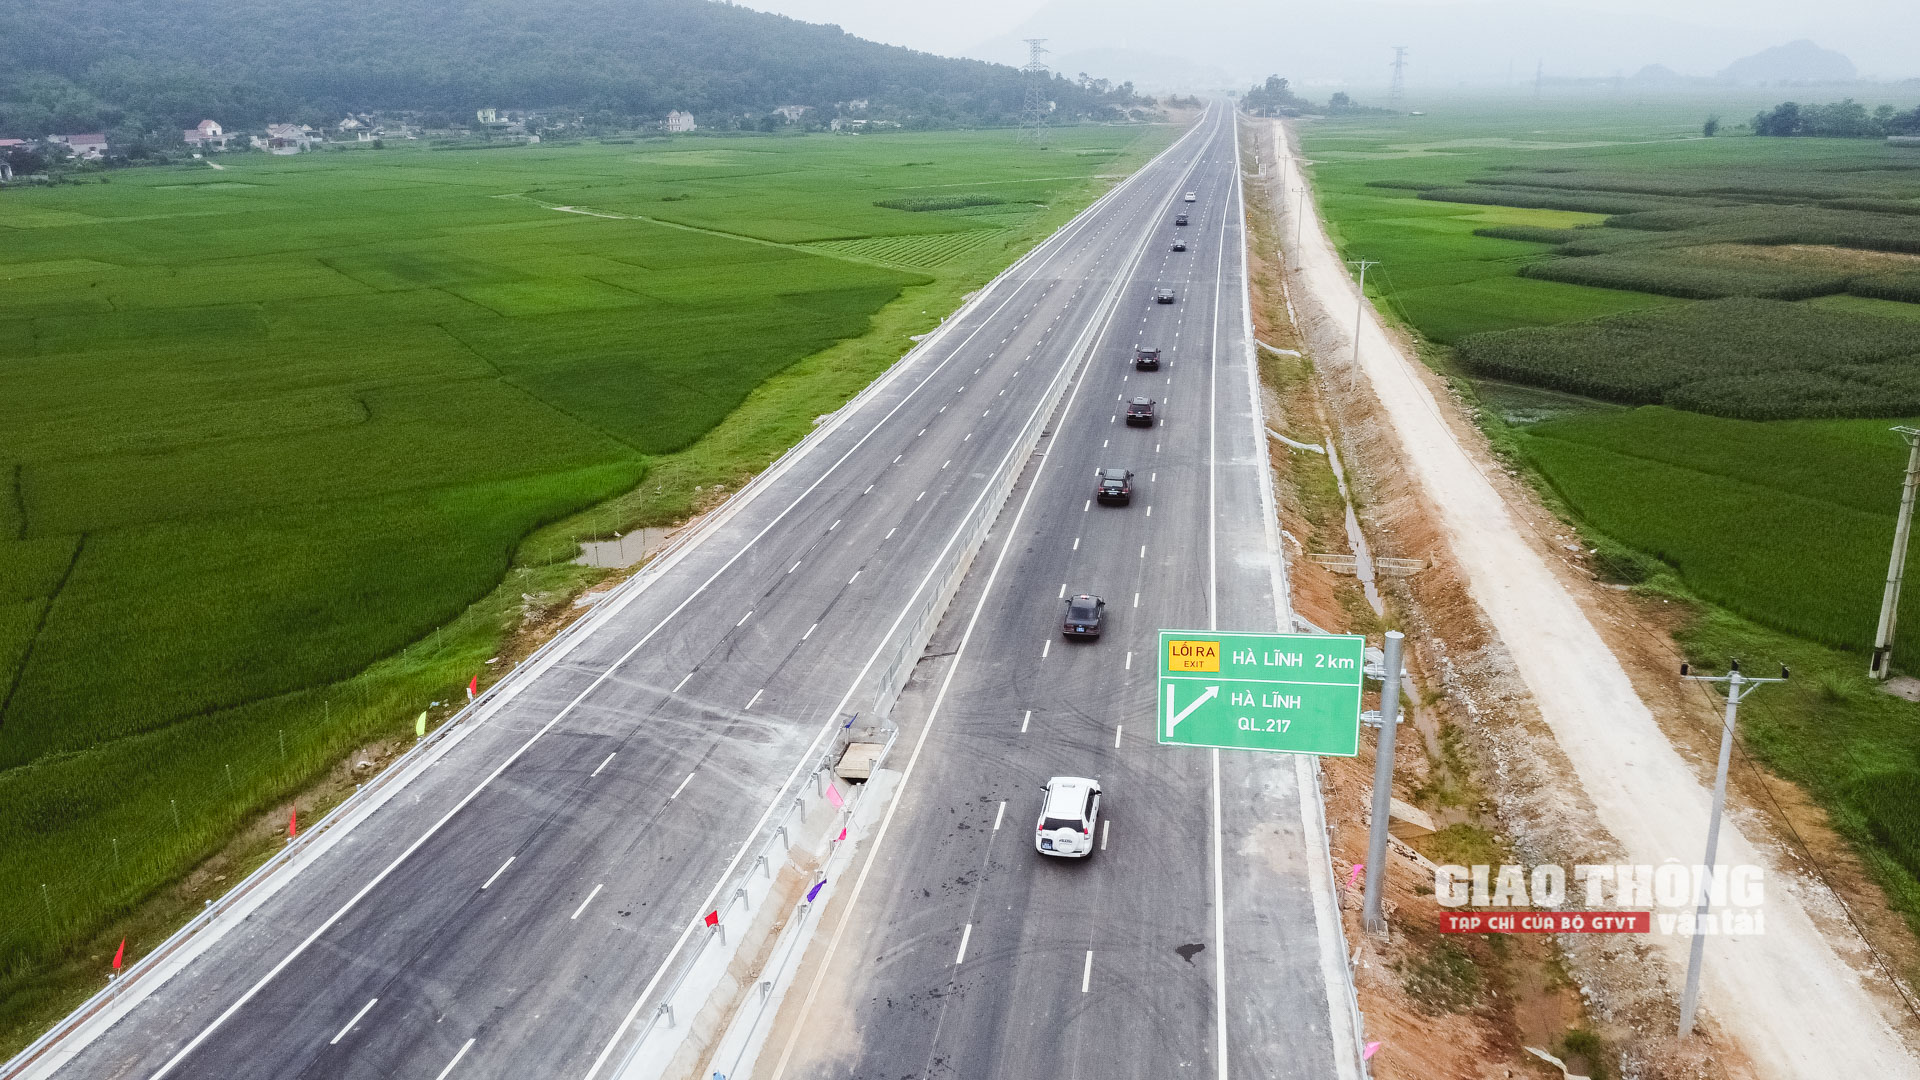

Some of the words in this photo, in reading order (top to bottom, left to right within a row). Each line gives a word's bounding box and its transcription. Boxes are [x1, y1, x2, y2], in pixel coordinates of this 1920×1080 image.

[1172, 641, 1193, 657] LỐI
[1196, 646, 1215, 657] RA
[1232, 647, 1257, 665] HÀ
[1264, 649, 1303, 667] LĨNH
[1184, 660, 1204, 668] EXIT
[1231, 689, 1256, 707] HÀ
[1262, 691, 1301, 709] LĨNH
[1238, 716, 1291, 733] QL.217
